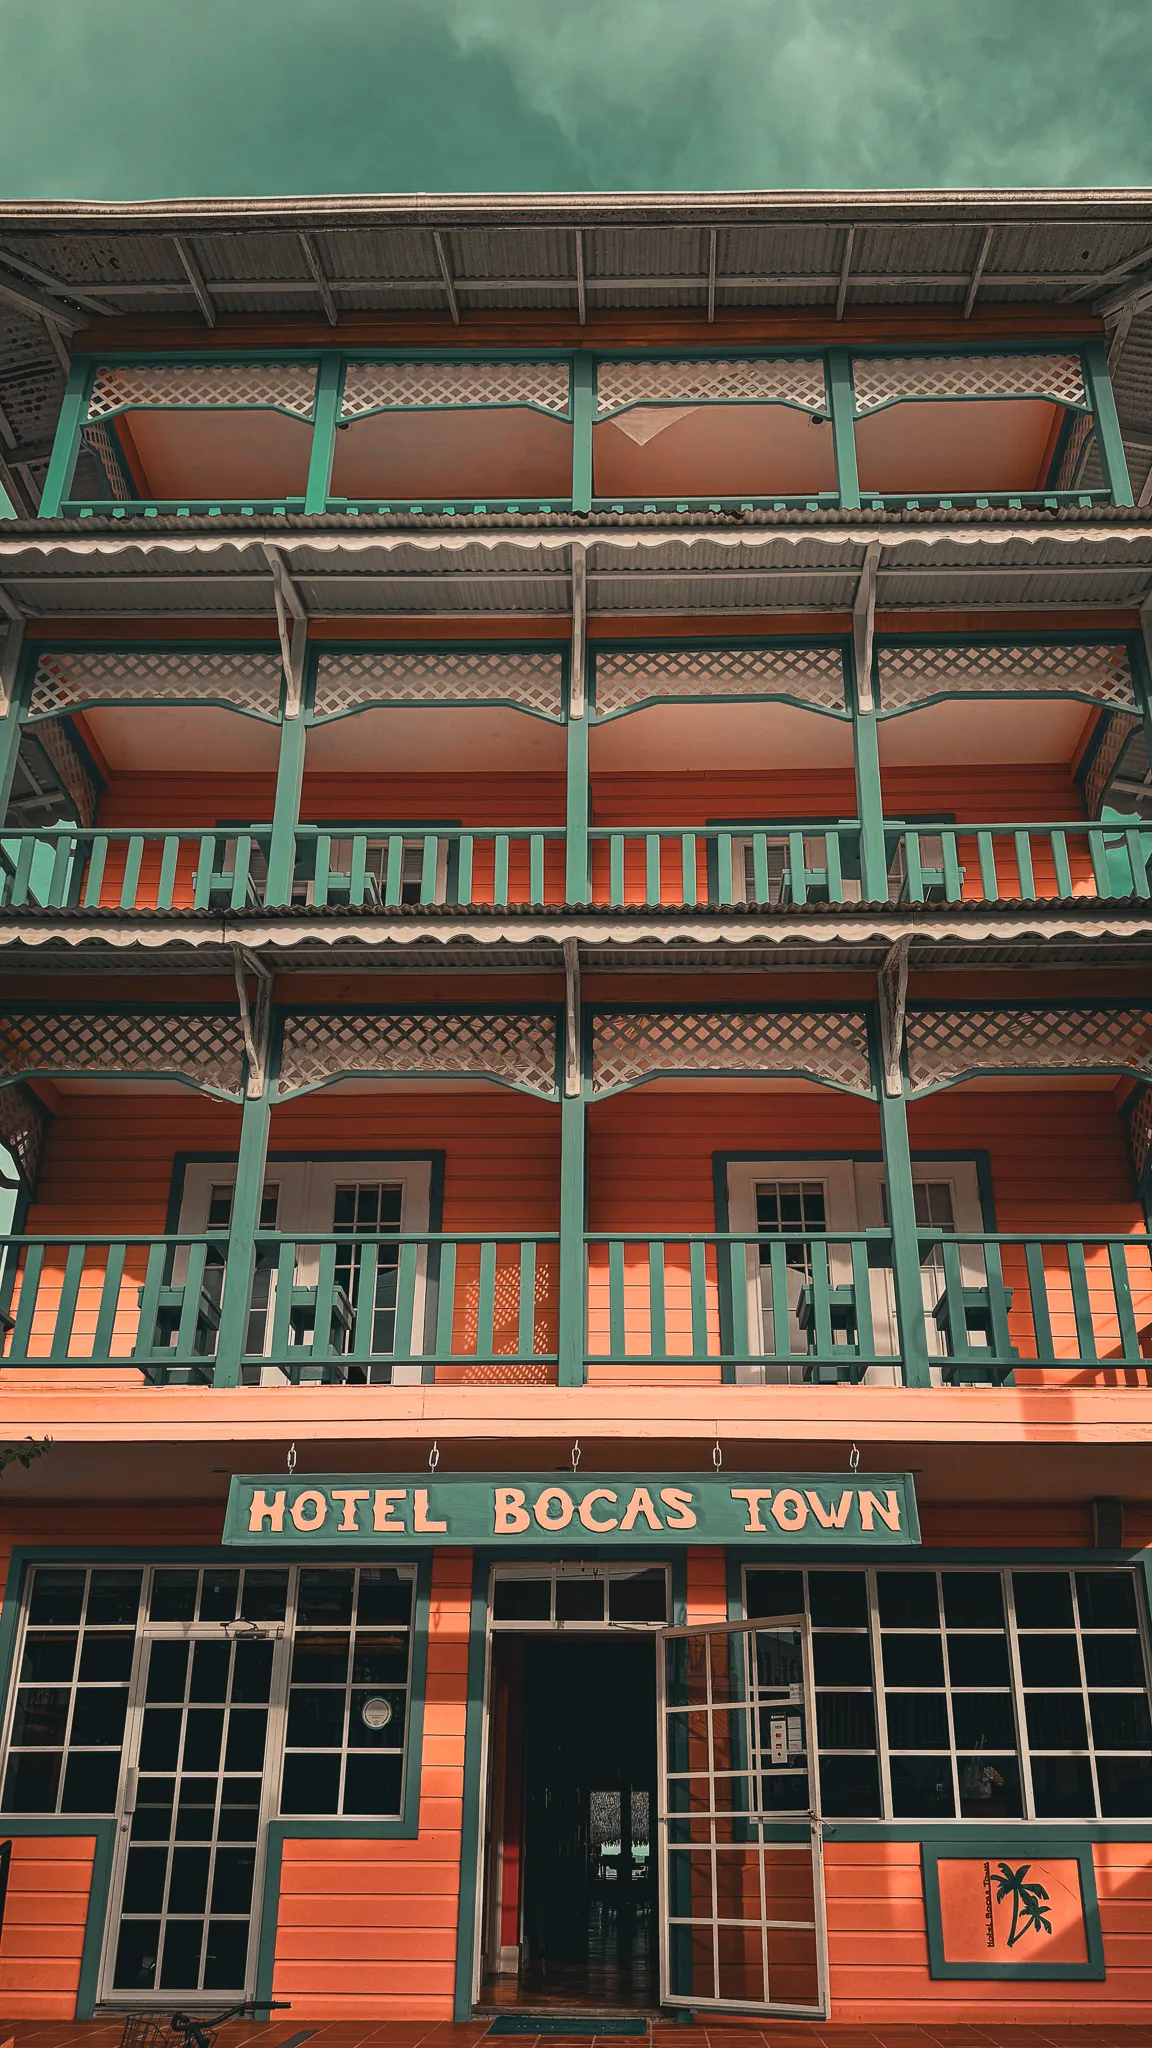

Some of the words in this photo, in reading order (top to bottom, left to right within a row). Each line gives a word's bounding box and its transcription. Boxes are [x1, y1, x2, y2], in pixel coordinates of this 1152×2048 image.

[248, 1489, 448, 1533] HOTEL
[494, 1487, 697, 1534] BOCAS
[731, 1488, 901, 1533] TOWN
